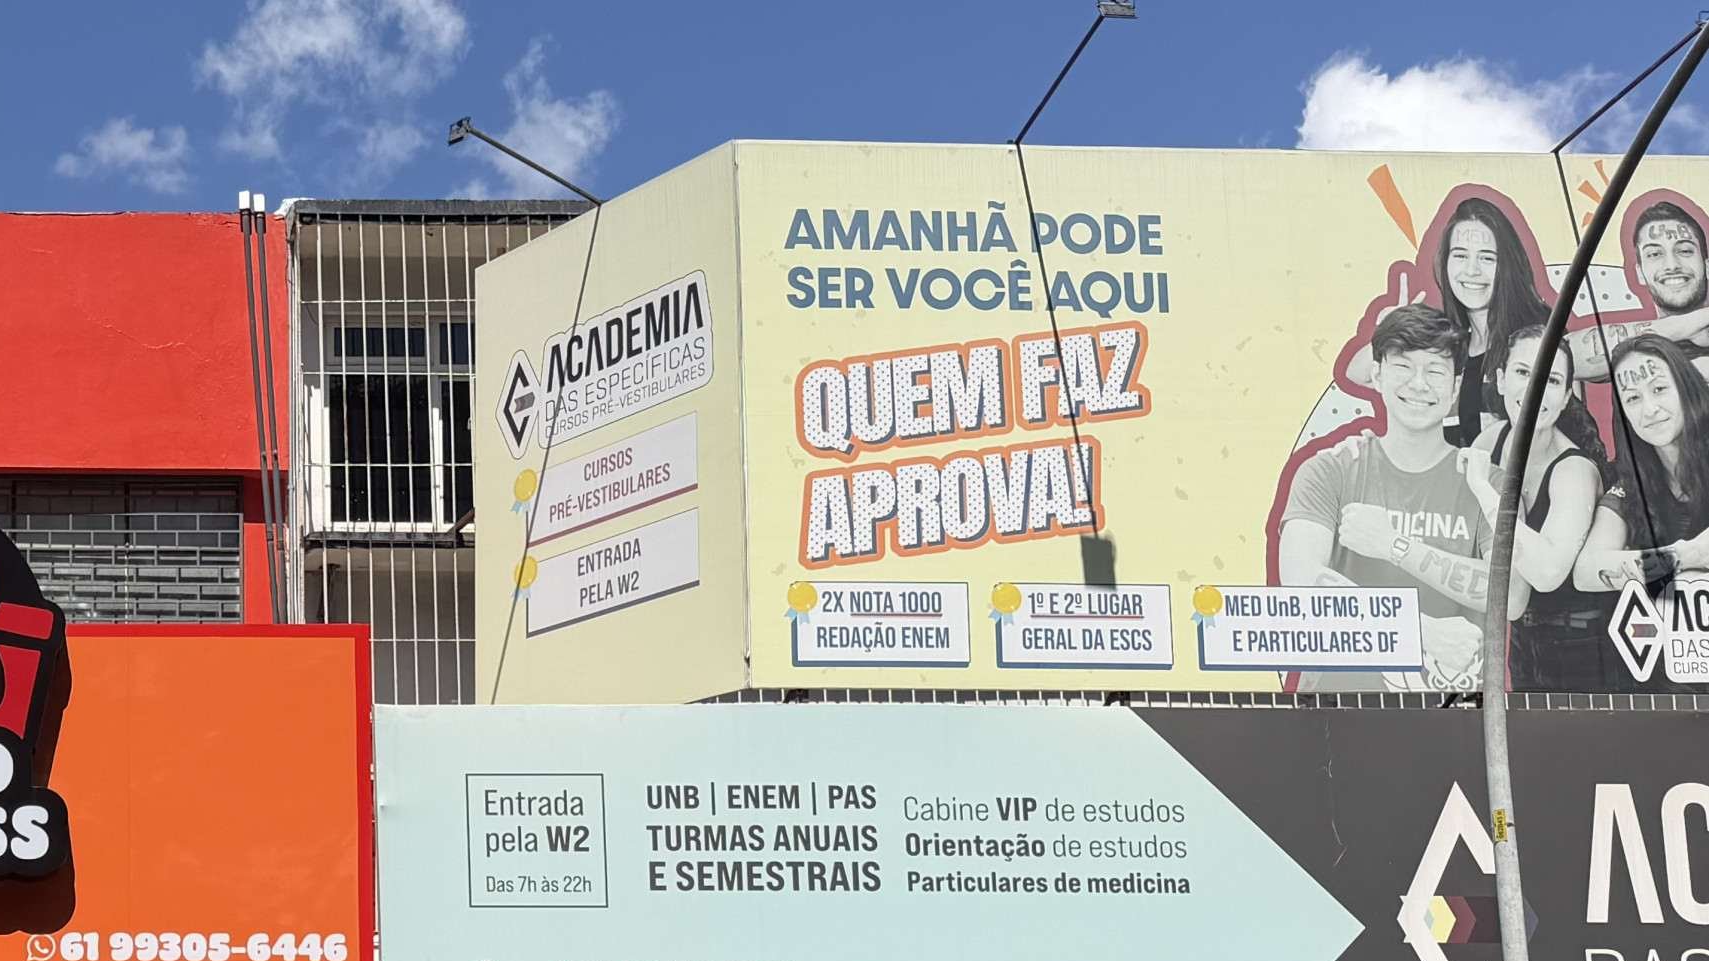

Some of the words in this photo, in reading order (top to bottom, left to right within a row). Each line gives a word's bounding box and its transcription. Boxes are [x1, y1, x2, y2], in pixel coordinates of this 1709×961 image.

[784, 201, 1018, 252] AMANHÃ
[1030, 212, 1163, 255] PODE
[786, 266, 875, 309] SER
[884, 259, 1033, 311] VOCÊ
[1045, 270, 1170, 318] AQUI
[546, 281, 705, 394] ACADEMIA
[544, 388, 579, 423] DAS
[584, 336, 706, 401] ESPECÍFICAS
[801, 345, 1004, 455] QUEM
[1019, 327, 1144, 424] FAZ
[545, 410, 590, 440] CURSOS
[592, 362, 706, 420] PRÉ-VESTIBULARES
[583, 447, 633, 482] CURSOS
[549, 462, 671, 523] PRÉ-VESTIBULARES
[806, 442, 1098, 562] APROVA!
[577, 537, 642, 577] ENTRADA
[579, 581, 614, 608] PELA
[617, 571, 641, 597] W2
[822, 591, 844, 613] 2X
[850, 591, 894, 613] NOTA
[898, 591, 942, 613] 1000
[1027, 592, 1044, 615] 1º
[1064, 593, 1082, 615] 2º
[1087, 593, 1143, 615] LUGAR
[1225, 595, 1262, 618] MED
[1266, 594, 1307, 620] UnB,
[1311, 595, 1364, 621] UFMG,
[1369, 596, 1402, 618] USP
[816, 622, 896, 653] REDAÇÃO
[901, 626, 950, 649] ENEM
[1022, 627, 1077, 651] GERAL
[1082, 628, 1106, 650] DA
[1110, 628, 1153, 652] ESCS
[1247, 629, 1372, 654] PARTICULARES
[1377, 631, 1399, 654] DF
[484, 789, 584, 816] Entrada
[646, 785, 700, 809] UNB
[727, 785, 801, 809] ENEM
[828, 785, 877, 809] PAS
[903, 796, 989, 821] Cabine
[996, 797, 1037, 822] VIP
[1045, 798, 1075, 823] de
[1083, 799, 1185, 823] estudos
[485, 825, 538, 857] pela
[546, 825, 590, 853] W2
[646, 825, 765, 851] TURMAS
[773, 825, 878, 852] ANUAIS
[905, 832, 1046, 862] Orientação
[1053, 834, 1082, 858] de
[1089, 835, 1187, 858] estudos
[486, 876, 514, 893] Das
[518, 876, 537, 893] 7h
[541, 876, 559, 893] às
[563, 876, 592, 893] 22h
[675, 861, 882, 892] SEMESTRAIS
[907, 871, 1048, 893] Particulares
[1054, 873, 1081, 893] de
[1087, 873, 1191, 894] medicina
[60, 931, 99, 961] 61
